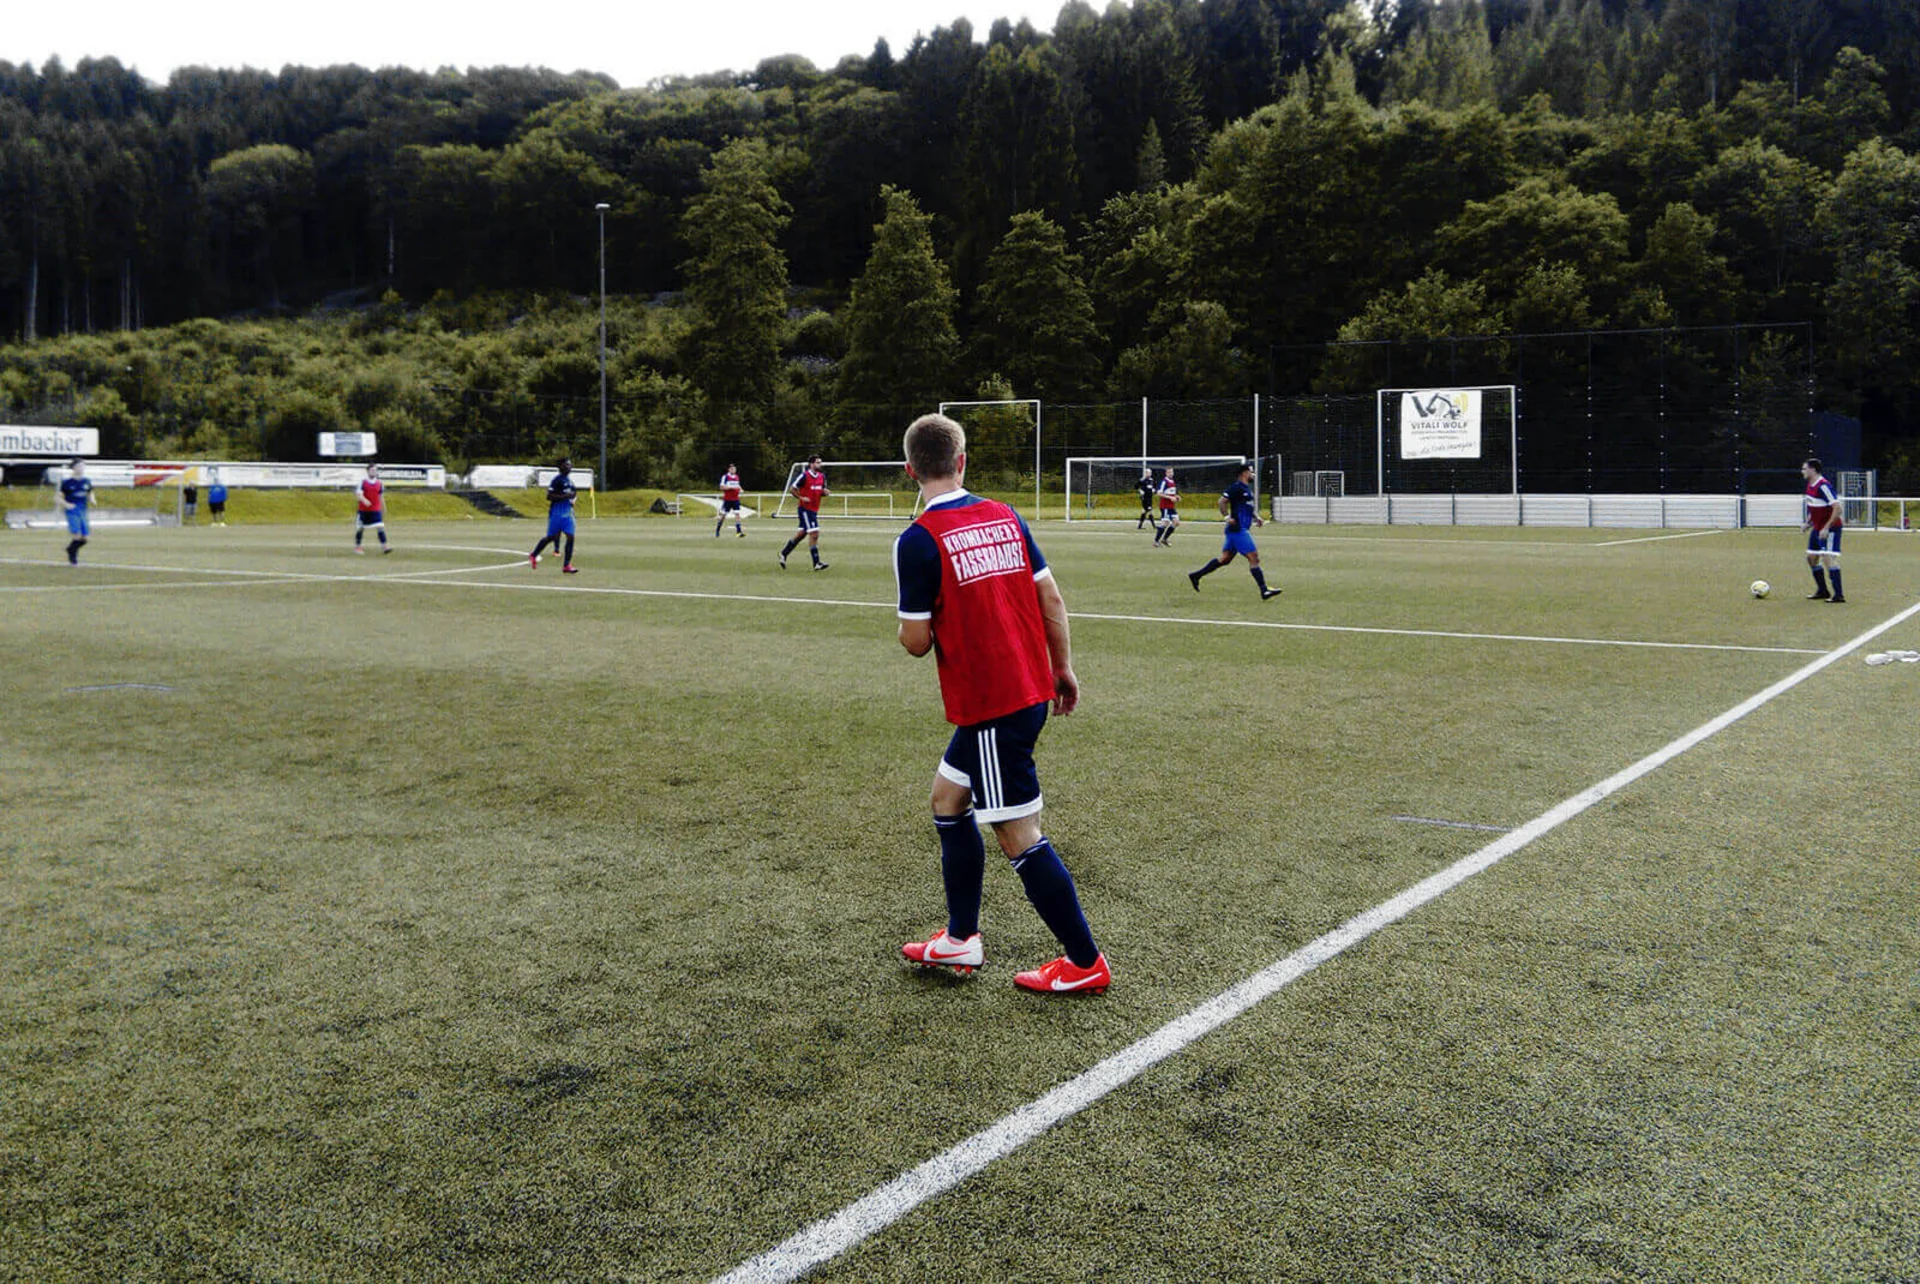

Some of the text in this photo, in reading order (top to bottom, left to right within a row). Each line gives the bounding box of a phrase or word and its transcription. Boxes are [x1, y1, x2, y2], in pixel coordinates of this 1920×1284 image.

[1443, 421, 1468, 429] WOLF
[0, 428, 83, 451] mbacher
[950, 542, 1026, 581] FASSBRAUSE
